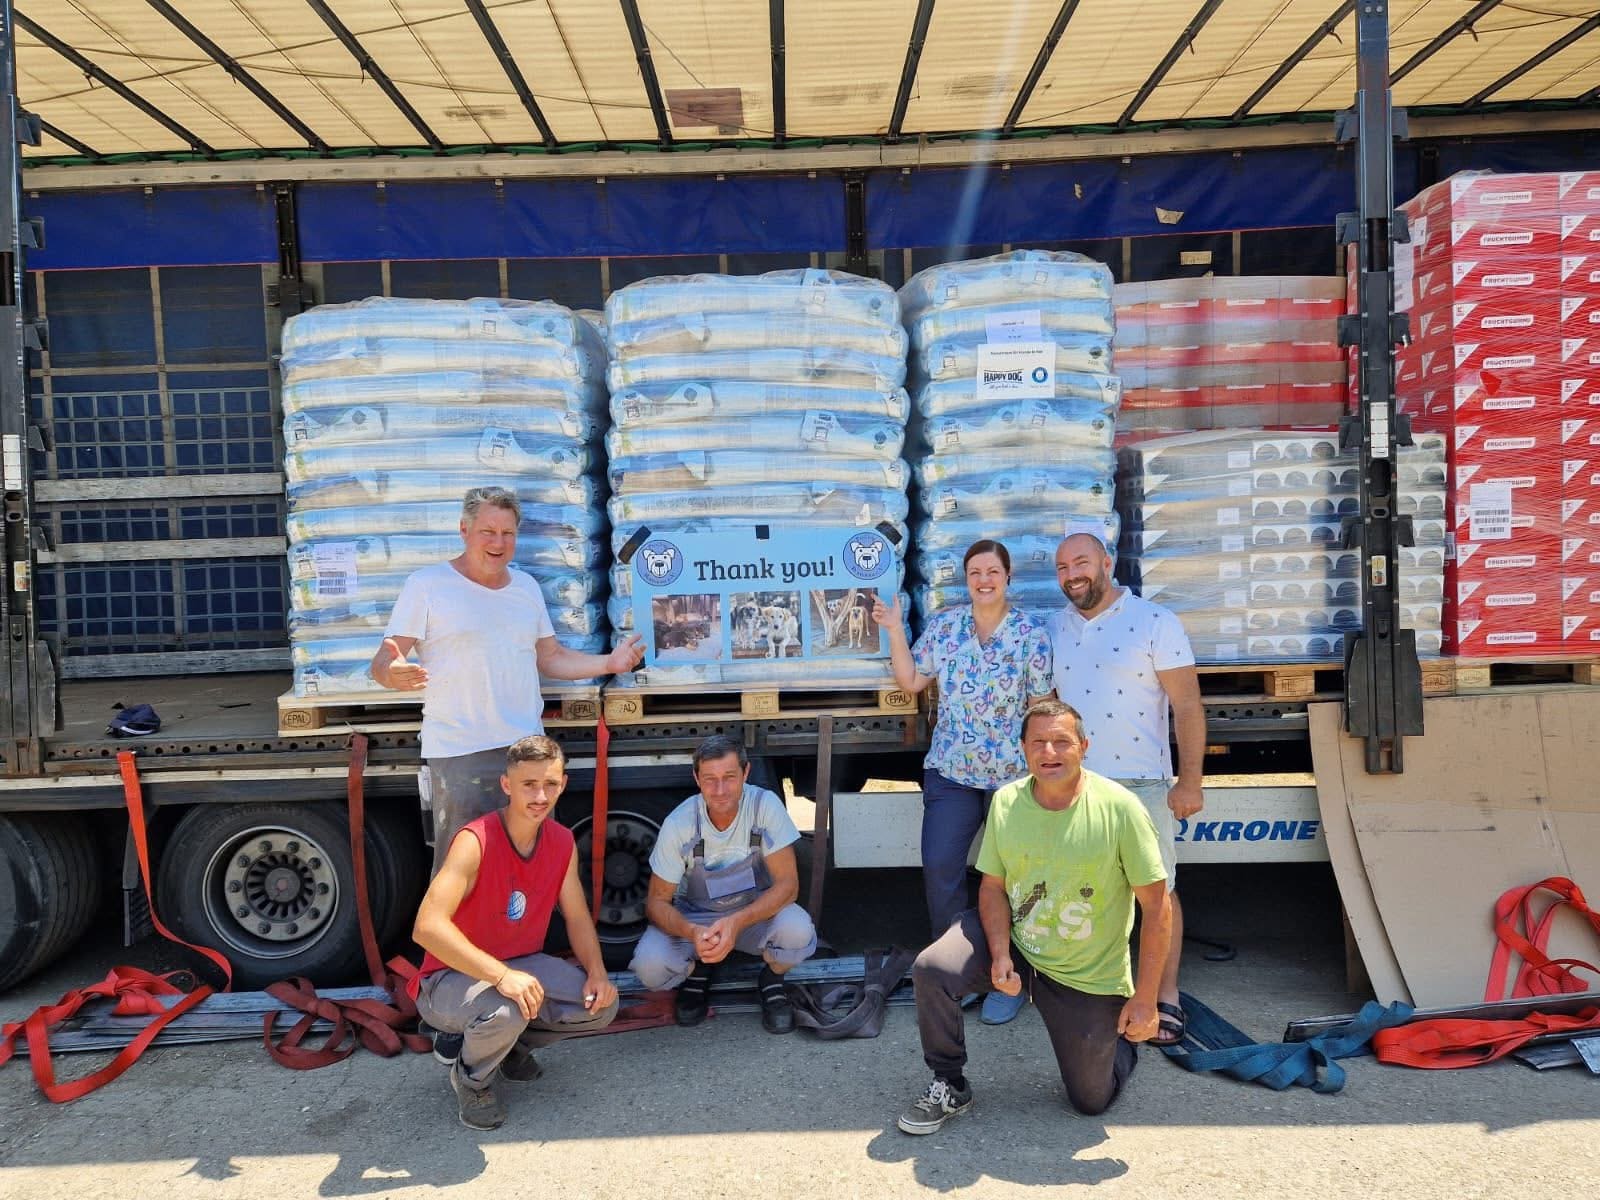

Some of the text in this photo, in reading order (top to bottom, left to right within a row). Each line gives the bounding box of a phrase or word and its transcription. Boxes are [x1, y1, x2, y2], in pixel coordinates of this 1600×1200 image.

[984, 371, 1022, 382] HAPPY DOG
[694, 558, 775, 580] Thank
[780, 555, 834, 583] you!
[889, 693, 905, 704] EPAL
[287, 714, 305, 724] EPAL
[1192, 820, 1319, 842] KRONE
